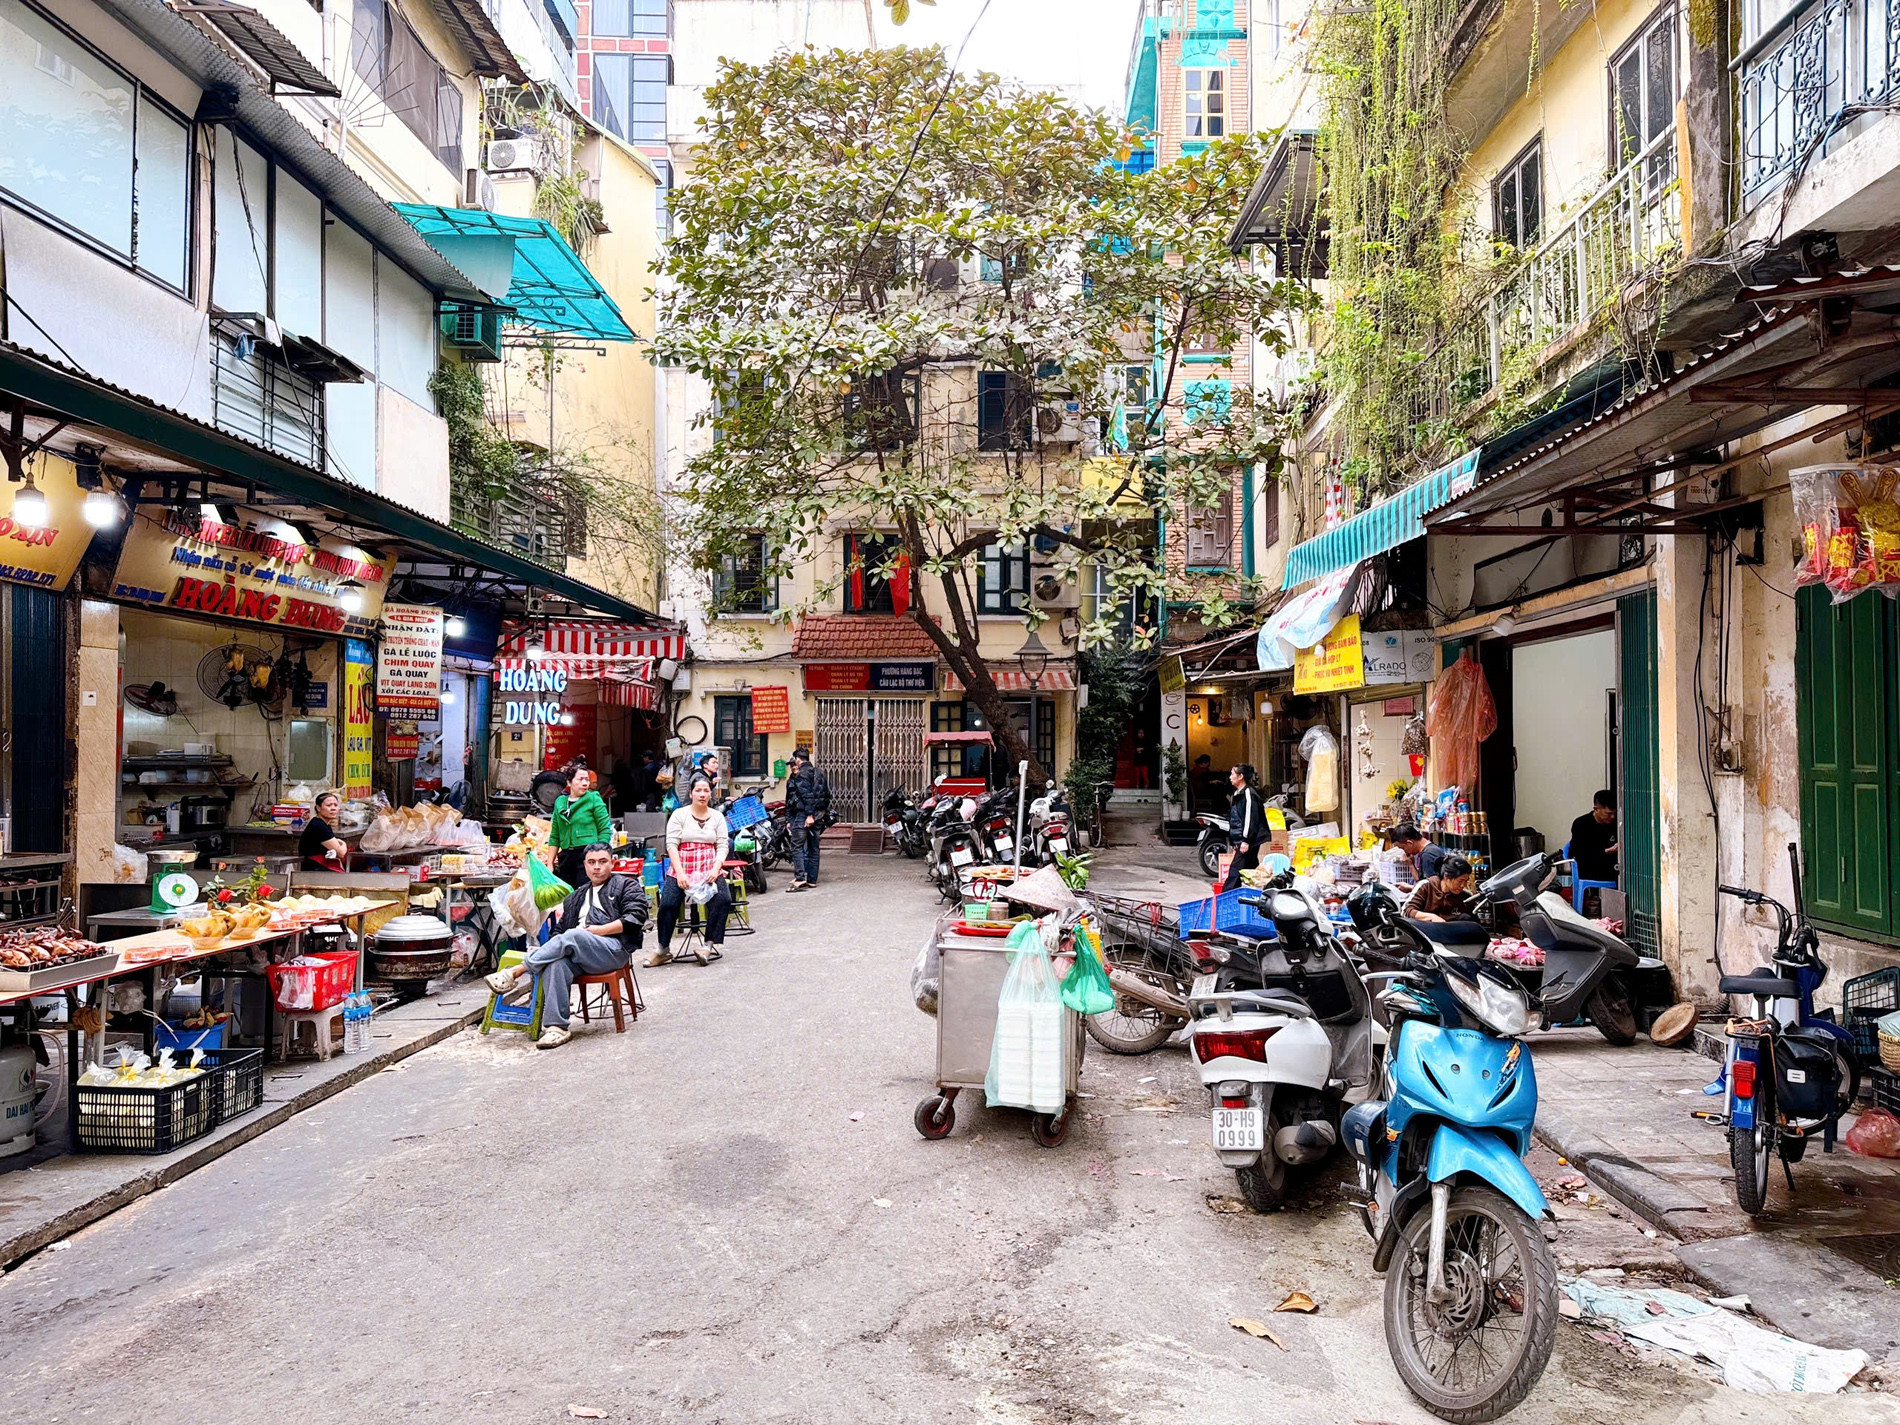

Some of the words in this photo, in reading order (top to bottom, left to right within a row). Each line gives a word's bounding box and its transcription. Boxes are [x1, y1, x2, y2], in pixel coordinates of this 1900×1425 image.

[172, 573, 282, 621] HOÀNG
[282, 598, 347, 632] DUNG
[395, 607, 420, 615] HOÀNG
[385, 624, 414, 633] NHẬN
[383, 646, 397, 656] GÀ
[399, 647, 411, 657] LỄ
[412, 650, 437, 659] LUỘC
[383, 658, 410, 667] CHIM
[411, 660, 435, 669] QUAY
[389, 667, 403, 677] GÀ
[404, 670, 429, 678] QUAY
[499, 660, 567, 693] HOÀNG
[881, 665, 900, 676] PHƯỜNG
[900, 665, 913, 676] HÀNG
[913, 666, 923, 677] BẠC
[391, 679, 407, 687] QUAY
[423, 681, 437, 689] SƠN
[889, 679, 898, 688] LẠC
[898, 677, 905, 688] BỘ
[504, 701, 561, 725] DUNG
[1455, 1032, 1485, 1042] HONDA
[1218, 1111, 1255, 1128] 30-H9
[1218, 1130, 1256, 1147] 0999
